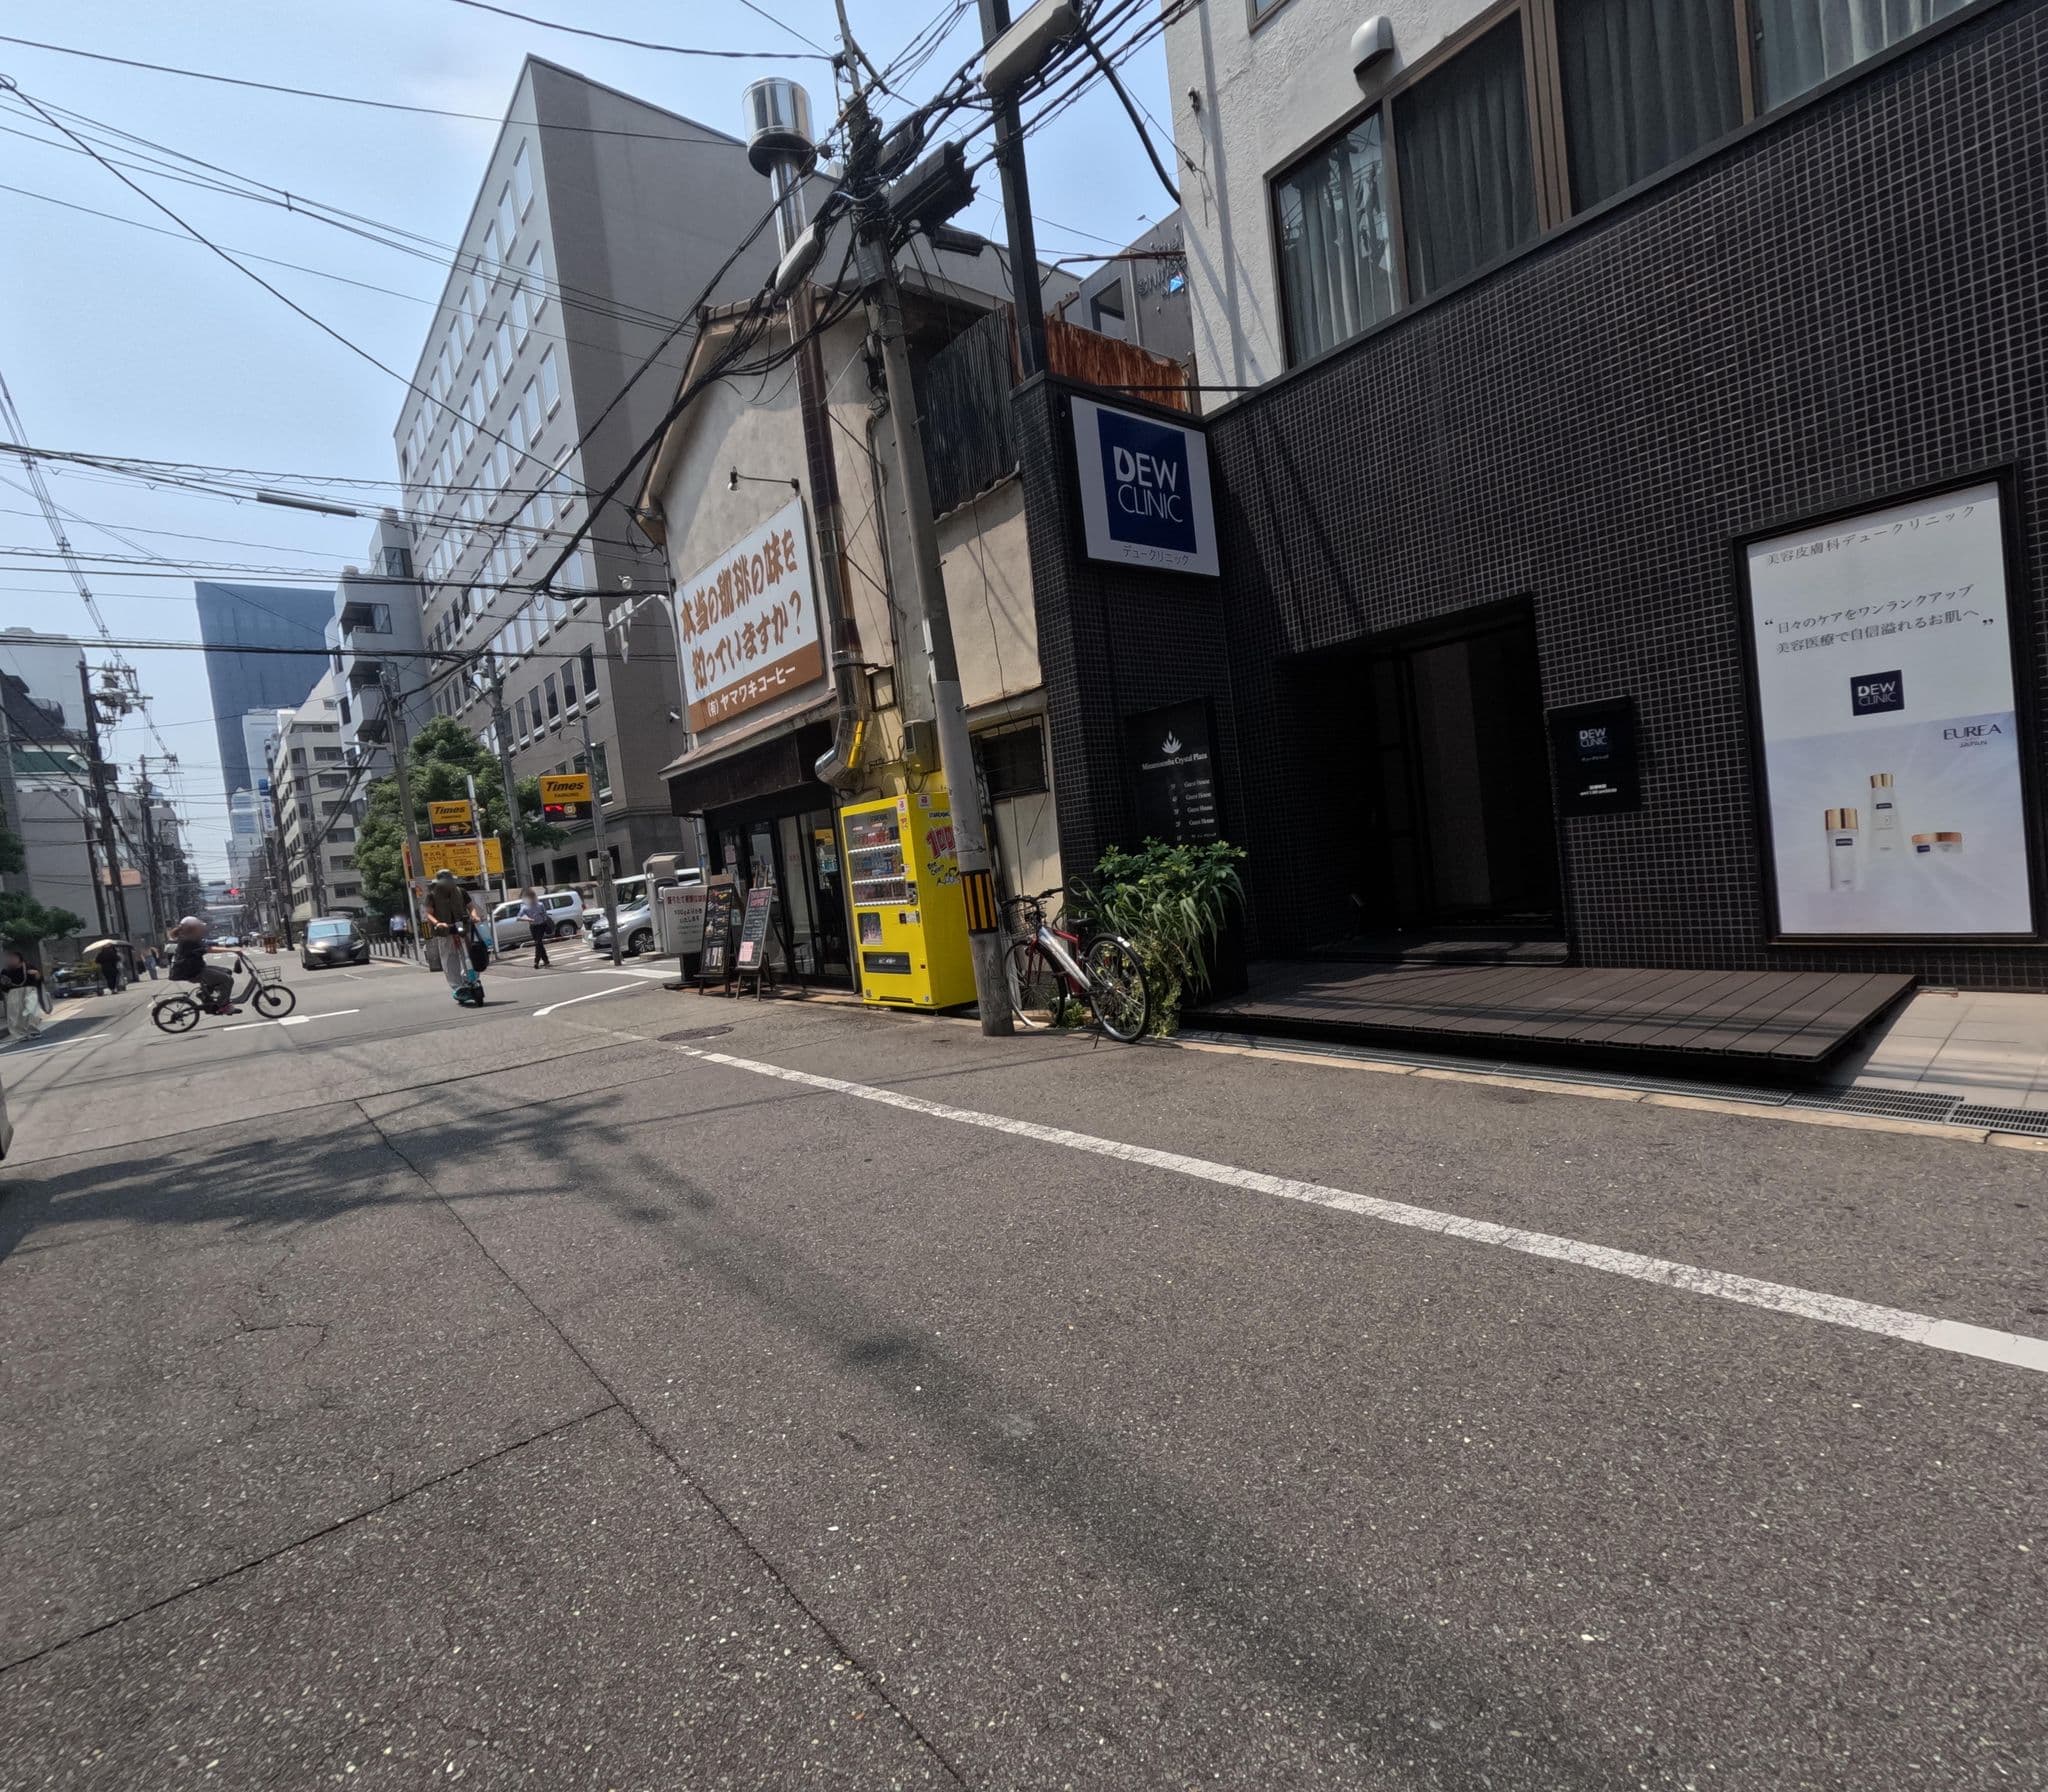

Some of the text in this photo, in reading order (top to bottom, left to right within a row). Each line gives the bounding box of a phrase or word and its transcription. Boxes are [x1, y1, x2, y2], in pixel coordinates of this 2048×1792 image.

[1112, 445, 1178, 492] DEW
[1117, 484, 1183, 523] CLINIC
[1767, 505, 1975, 566] 美容皮膚科デュークリニック
[1122, 545, 1191, 566] デュークリニック
[681, 529, 798, 645] 本当の珈琲の味を
[1857, 681, 1896, 697] DEW
[1858, 692, 1897, 706] CLINIC
[1579, 728, 1606, 740] DEW
[1943, 723, 2002, 740] EUREA
[1580, 736, 1608, 747] CLINIC
[546, 781, 585, 792] Times
[435, 806, 465, 815] Times
